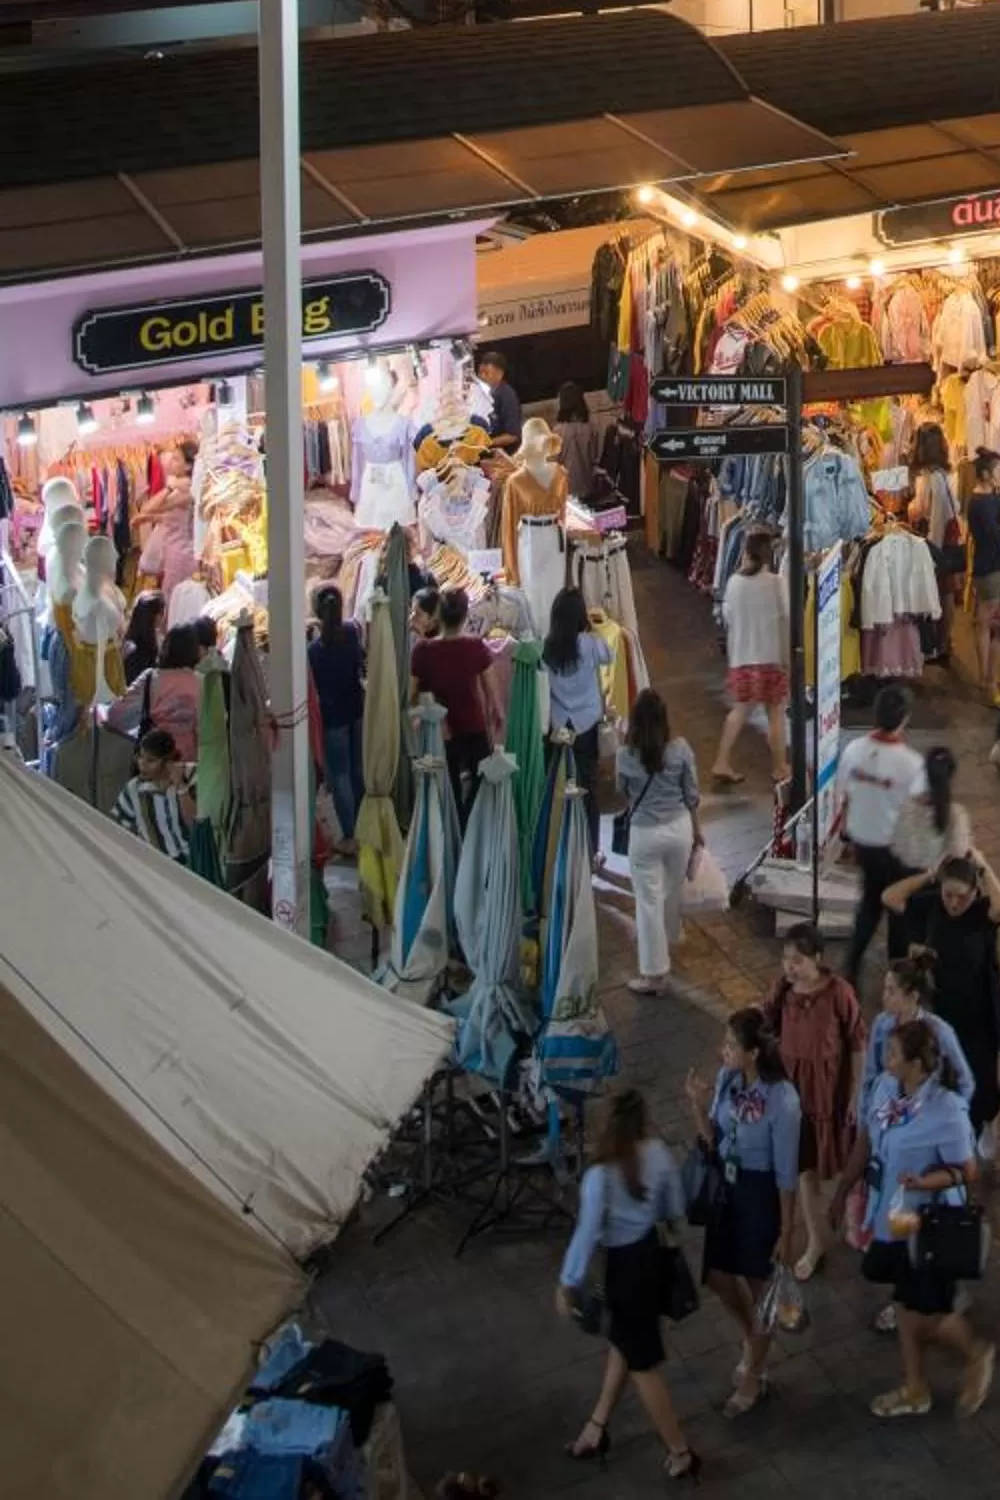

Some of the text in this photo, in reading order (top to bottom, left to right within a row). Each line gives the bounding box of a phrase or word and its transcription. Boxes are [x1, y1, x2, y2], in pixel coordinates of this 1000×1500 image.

[139, 303, 234, 351] Gold
[677, 382, 774, 401] VICTORY MALL
